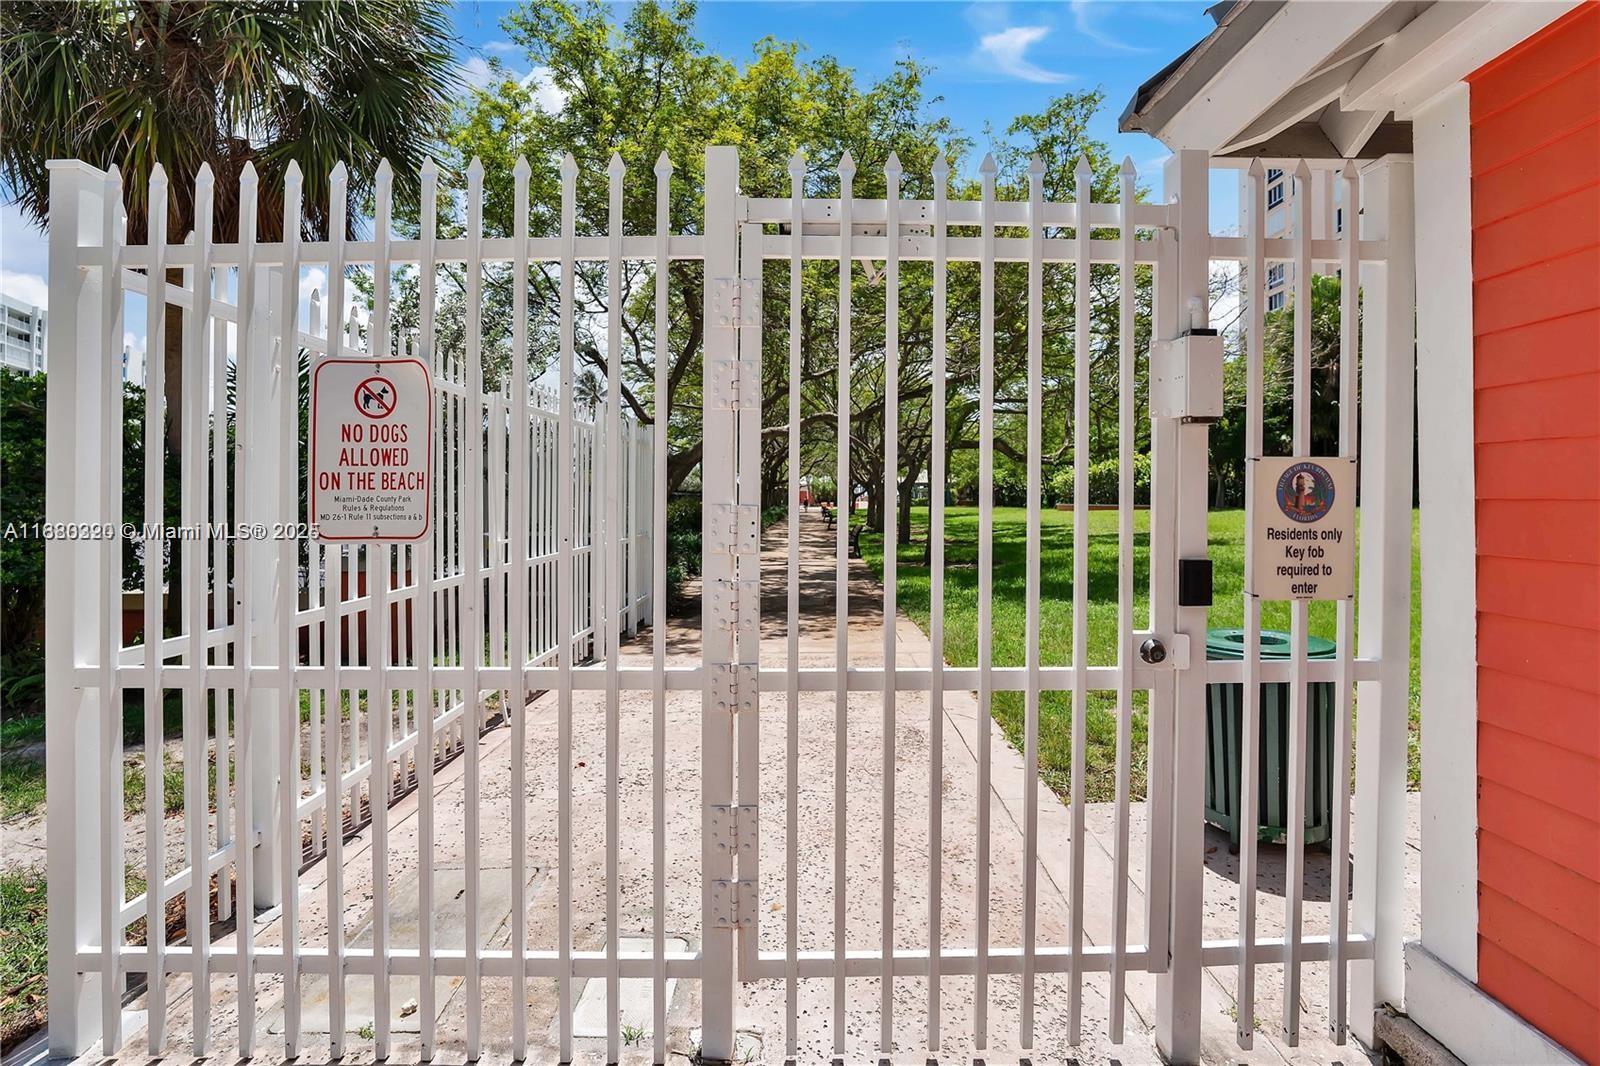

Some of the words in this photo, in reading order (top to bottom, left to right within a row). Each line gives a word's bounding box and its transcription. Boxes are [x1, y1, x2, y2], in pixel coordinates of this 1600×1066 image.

[342, 424, 363, 443] NO
[370, 424, 408, 442] DOGS
[339, 448, 408, 466] ALLOWED
[320, 472, 340, 490] ON
[348, 472, 375, 490] THE
[382, 472, 424, 490] BEACH
[376, 496, 396, 504] County
[1267, 528, 1318, 540] Residents
[1321, 528, 1342, 543] only
[1286, 546, 1304, 560] Key
[1308, 546, 1324, 558] fob
[1277, 564, 1319, 578] required
[1322, 564, 1332, 576] to
[1292, 582, 1318, 593] enter
